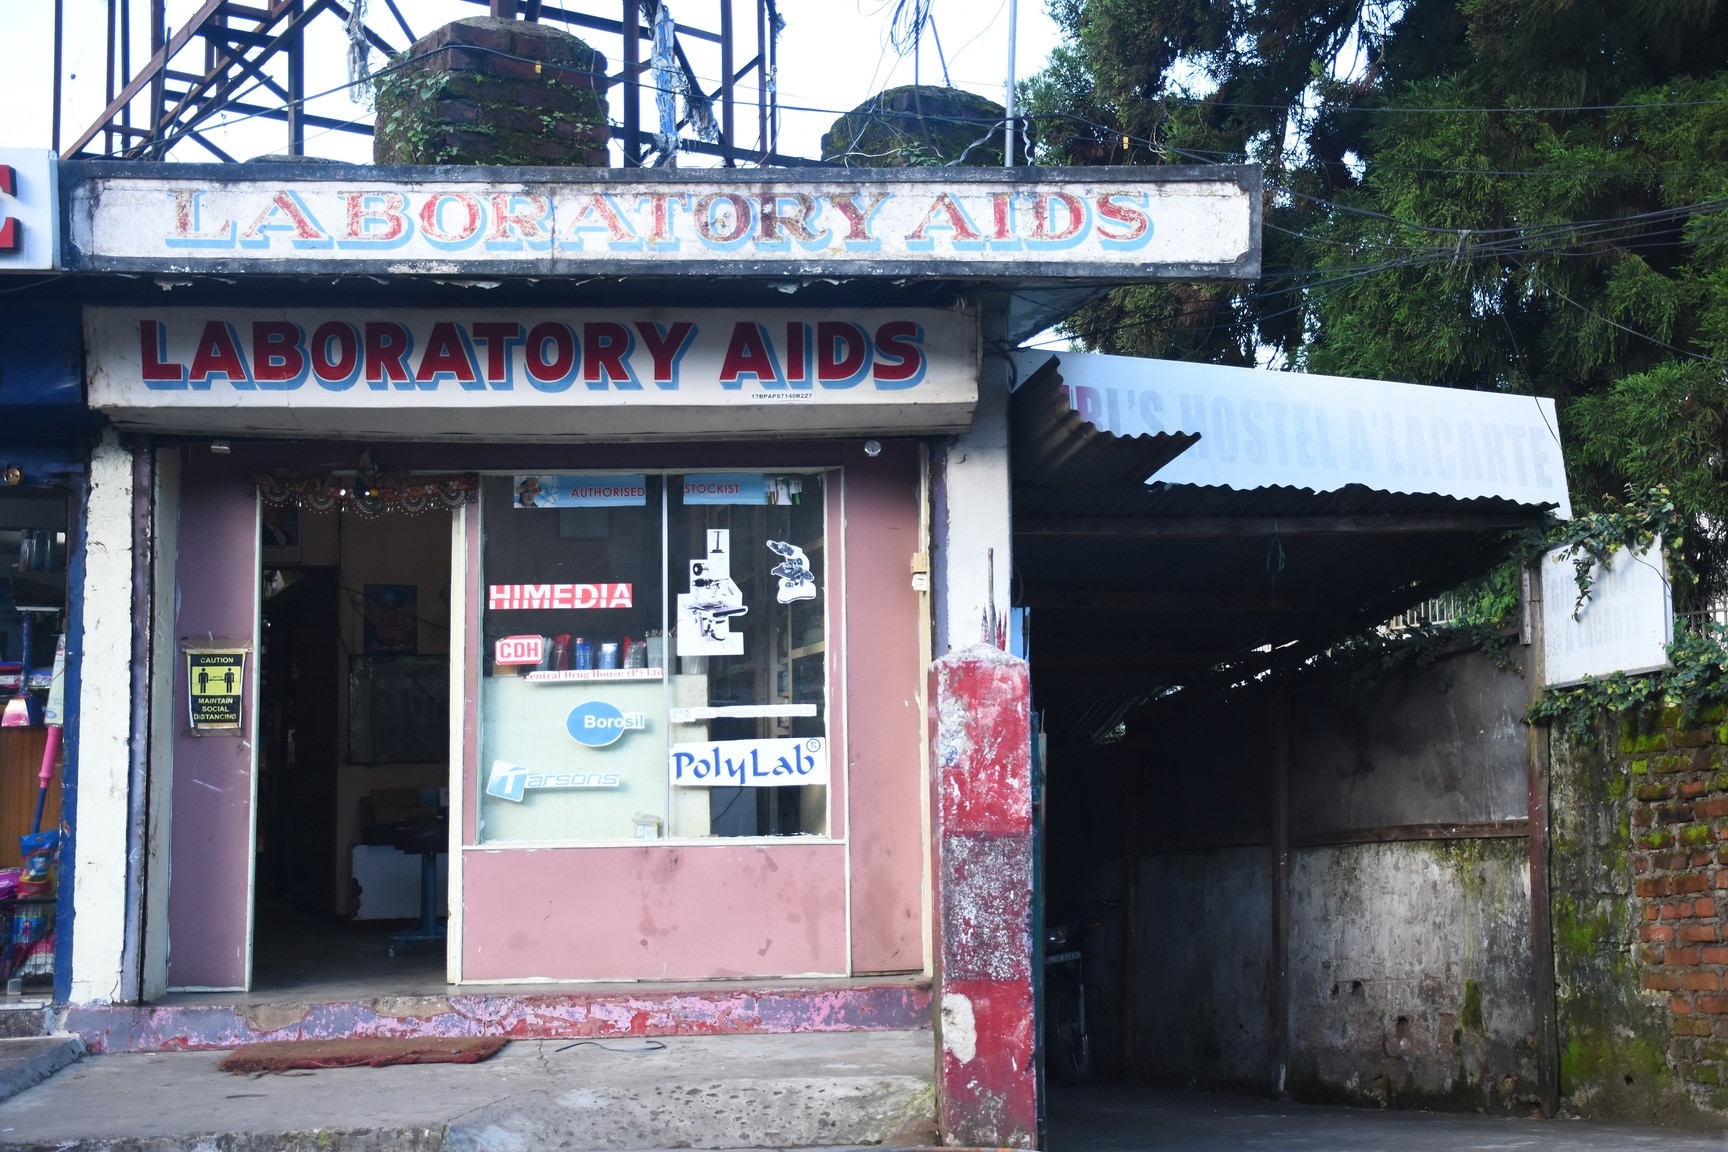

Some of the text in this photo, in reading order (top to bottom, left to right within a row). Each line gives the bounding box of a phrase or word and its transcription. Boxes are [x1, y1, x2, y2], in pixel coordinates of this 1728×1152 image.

[166, 188, 1155, 252] LABORATORY AIDS
[139, 320, 927, 390] LABORATORY AIDS
[1180, 393, 1338, 471] HOSTEL
[571, 483, 740, 498] AUTHORISED STOCKIST
[489, 583, 632, 609] HIMEDIA
[501, 642, 539, 659] CDH
[565, 671, 590, 679] Drug
[593, 670, 624, 678] House
[584, 714, 644, 729] Borosil
[671, 744, 815, 785] PolyLab
[494, 767, 619, 794] Tarsons
